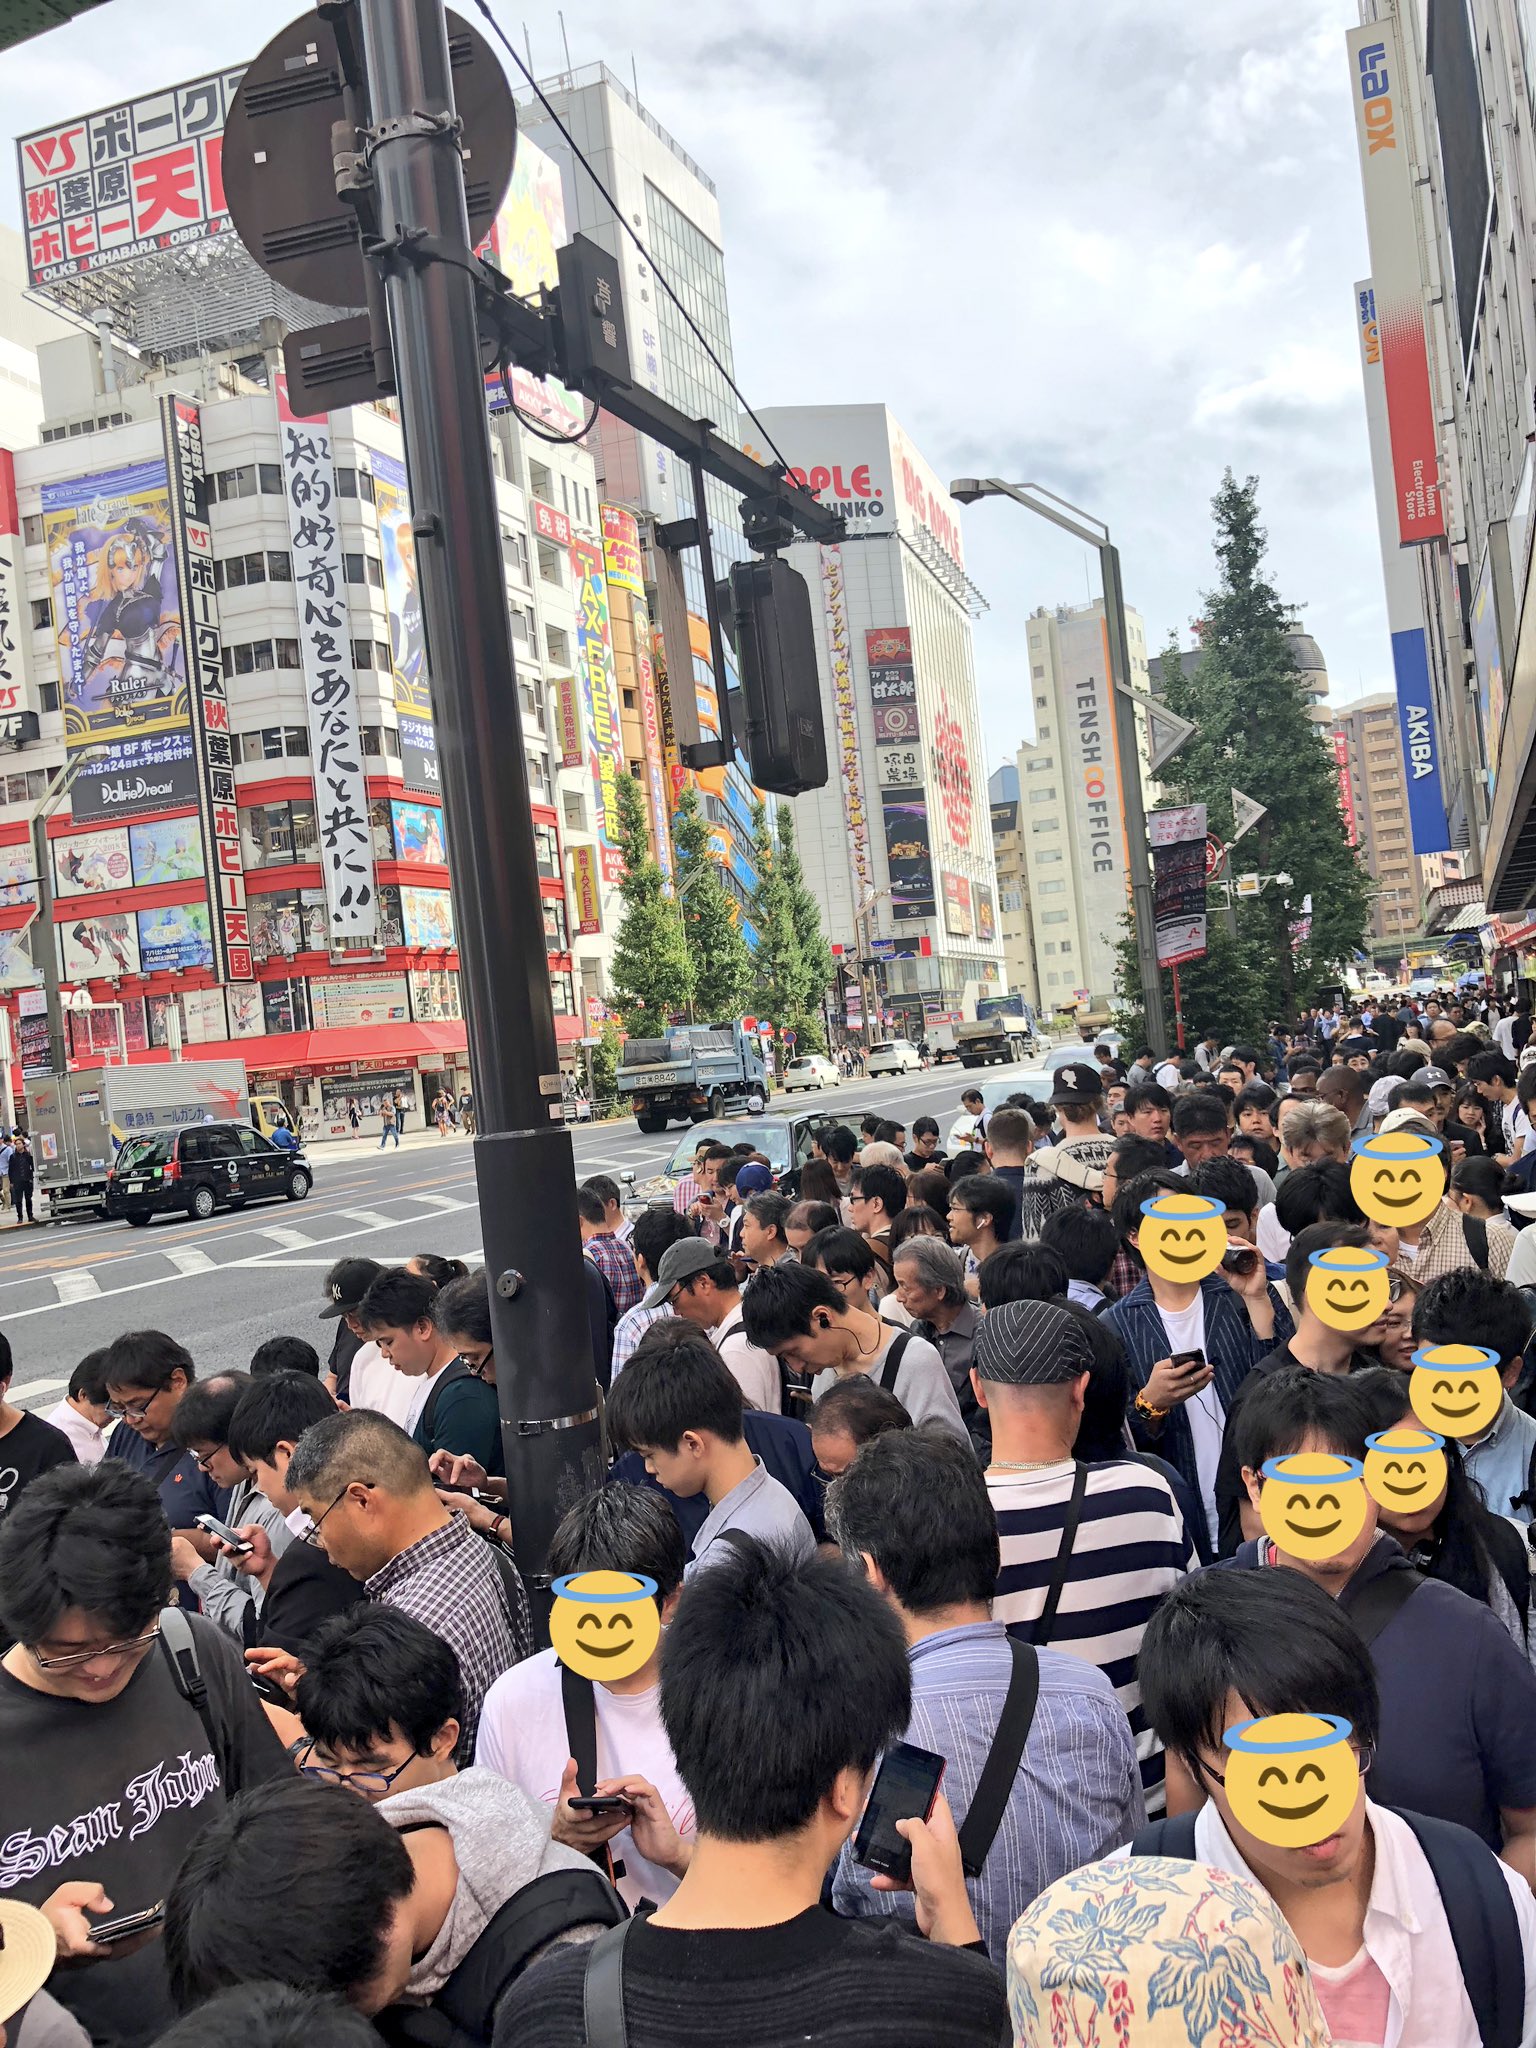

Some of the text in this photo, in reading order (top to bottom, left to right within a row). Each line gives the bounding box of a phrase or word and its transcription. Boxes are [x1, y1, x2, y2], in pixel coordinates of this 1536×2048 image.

[93, 76, 243, 162] ボーク
[28, 164, 130, 225] 秋葉原
[32, 216, 131, 267] ホビー
[34, 261, 77, 283] VOLKS
[80, 240, 155, 272] AKIHABARA
[158, 223, 207, 250] HOBBY
[175, 401, 197, 516] PARADISE
[188, 403, 204, 484] HOBBY
[902, 457, 927, 522] BIG
[1405, 490, 1417, 521] Store
[1412, 458, 1427, 519] Electronics
[1425, 484, 1437, 516] Home
[538, 507, 569, 541] 免税
[578, 552, 602, 636] TAX
[111, 676, 147, 694] Ruler
[584, 639, 613, 746] FREE
[871, 680, 915, 699] 甘太郎
[123, 742, 138, 755] 8F
[141, 735, 191, 752] ボークスに
[560, 681, 577, 750] 愛客旺免税店
[1405, 704, 1434, 780] AKIBA
[564, 753, 581, 761] AKKY
[1086, 778, 1113, 873] OFFICE
[578, 848, 588, 865] 免税
[582, 920, 597, 928] AKKY
[654, 1072, 676, 1083] 8842
[0, 1750, 221, 1889] Sean John
